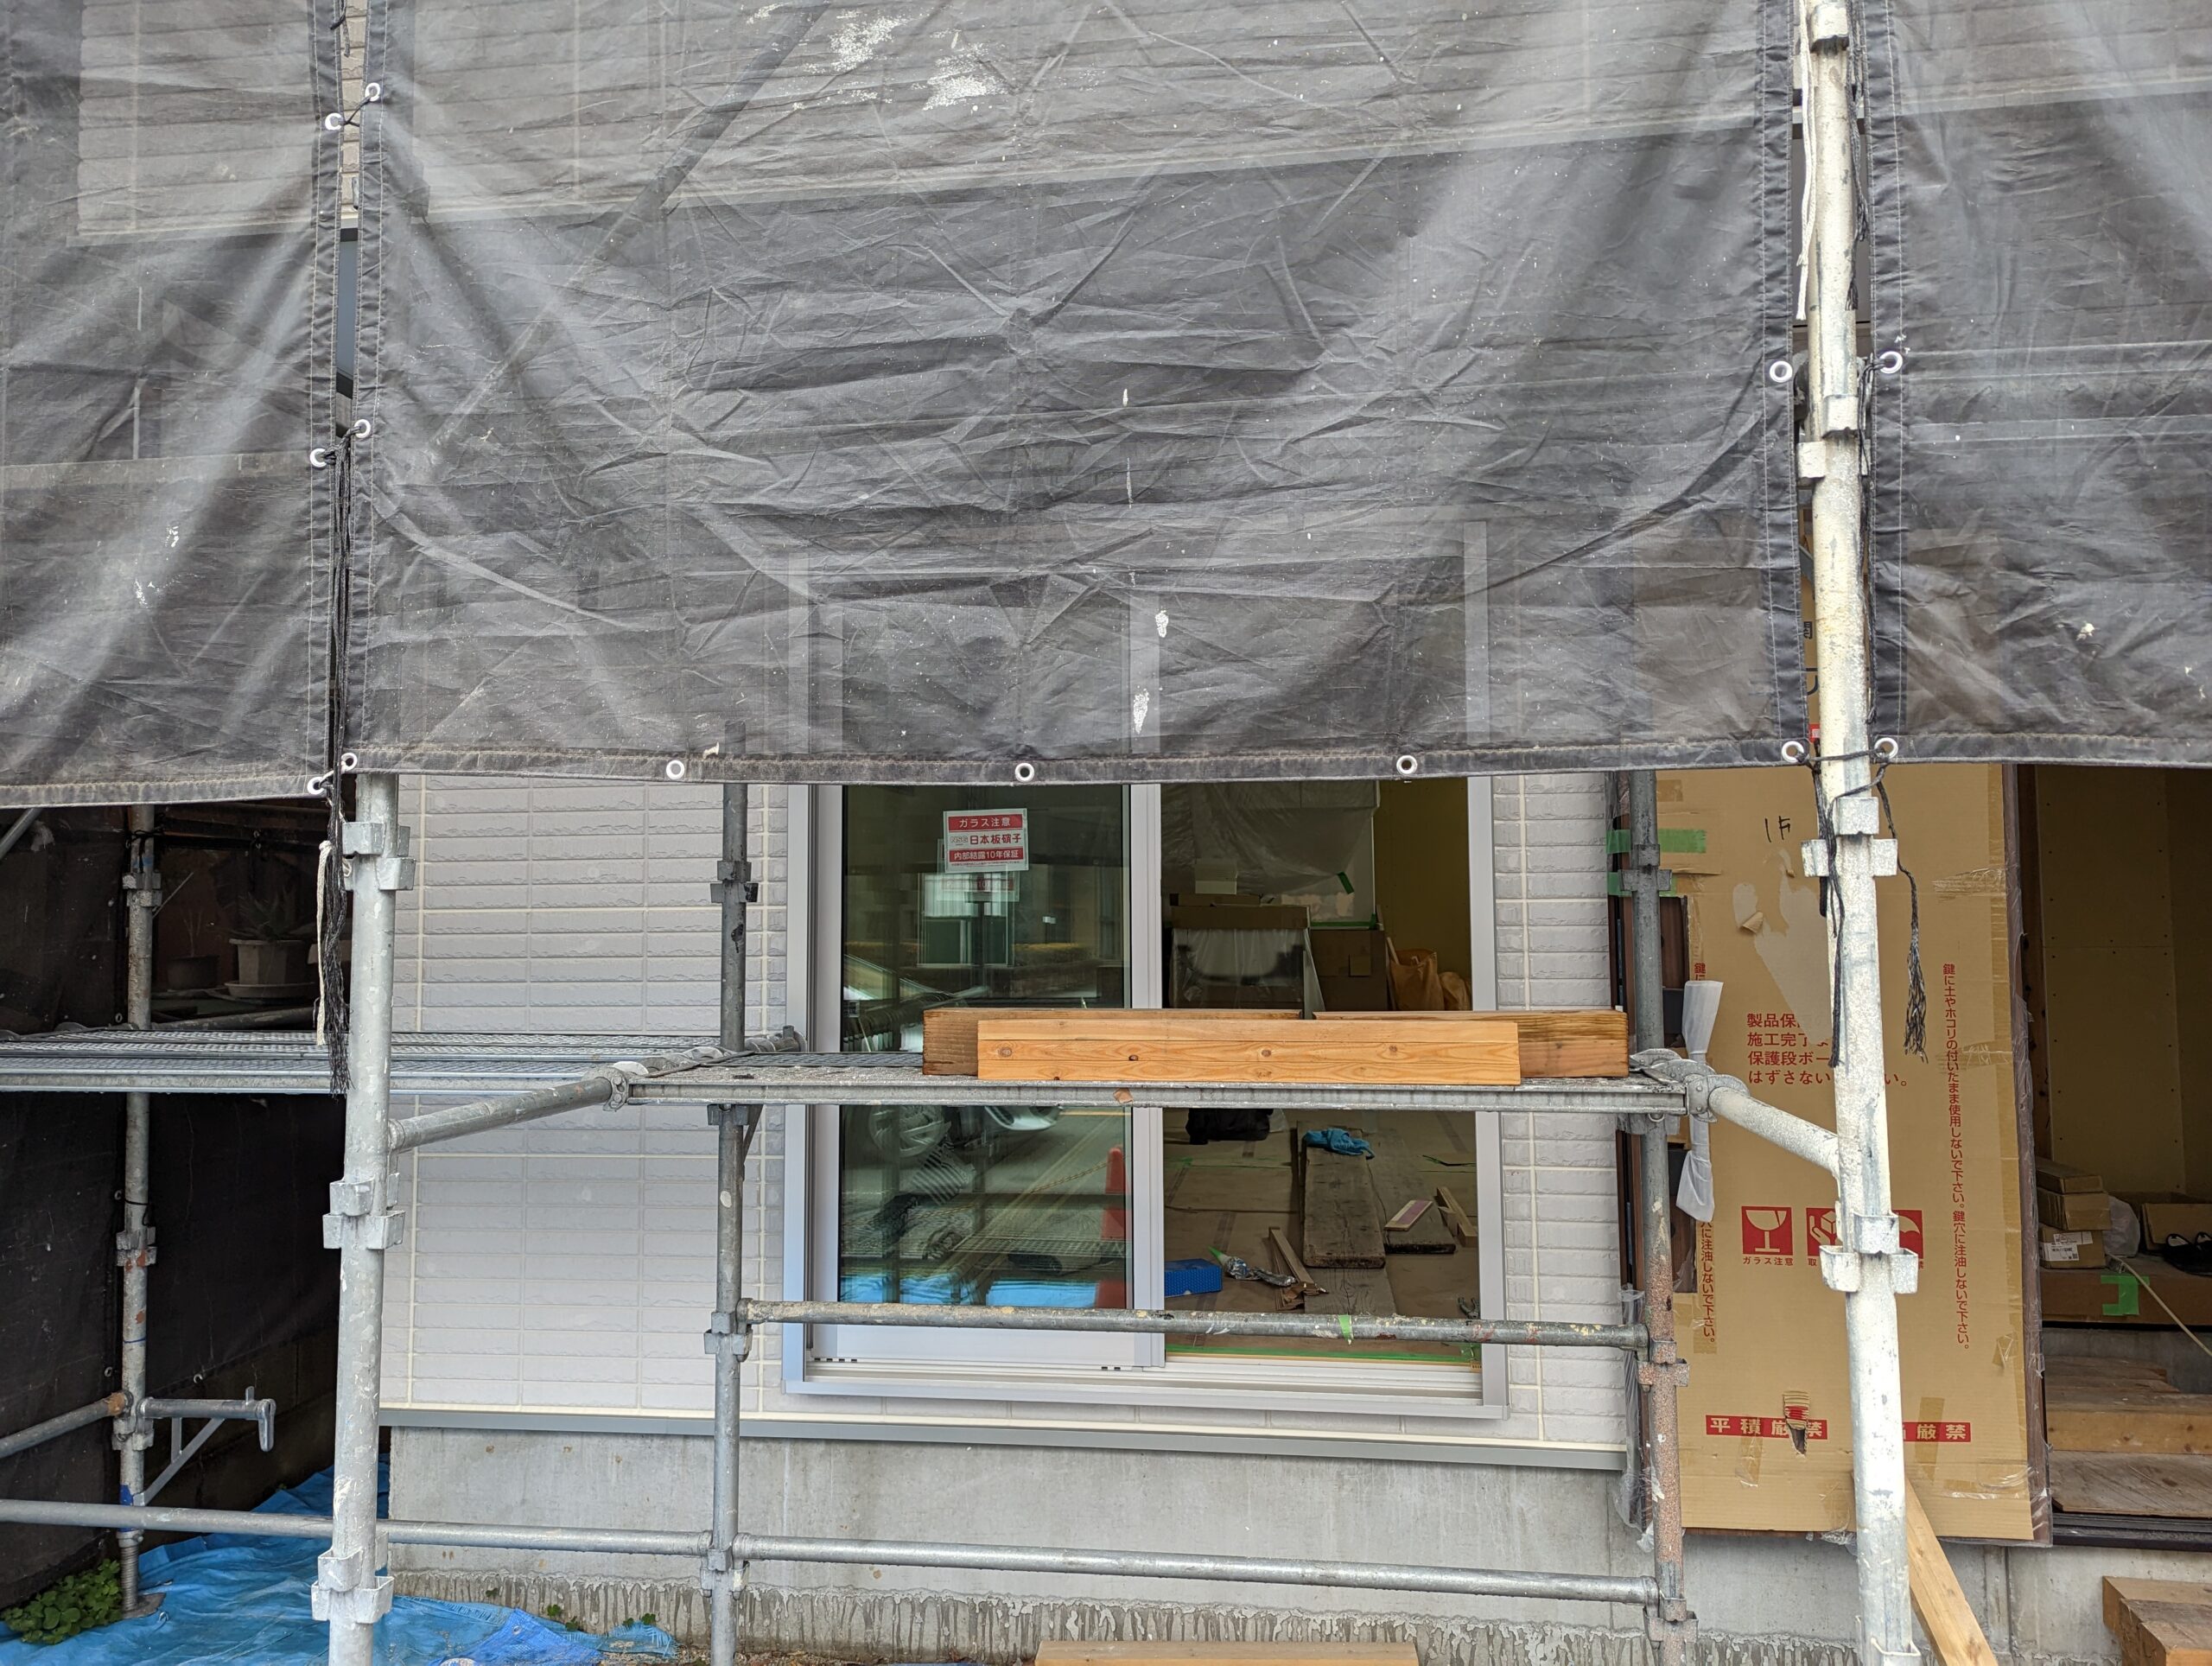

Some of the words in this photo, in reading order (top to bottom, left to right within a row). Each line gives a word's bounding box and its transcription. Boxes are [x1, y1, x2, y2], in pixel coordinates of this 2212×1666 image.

[959, 817, 1011, 828] ガラス注意
[969, 833, 1021, 845] 日本板硝子
[1747, 1013, 1801, 1028] 製品保
[1743, 1256, 1793, 1266] ガラス注意
